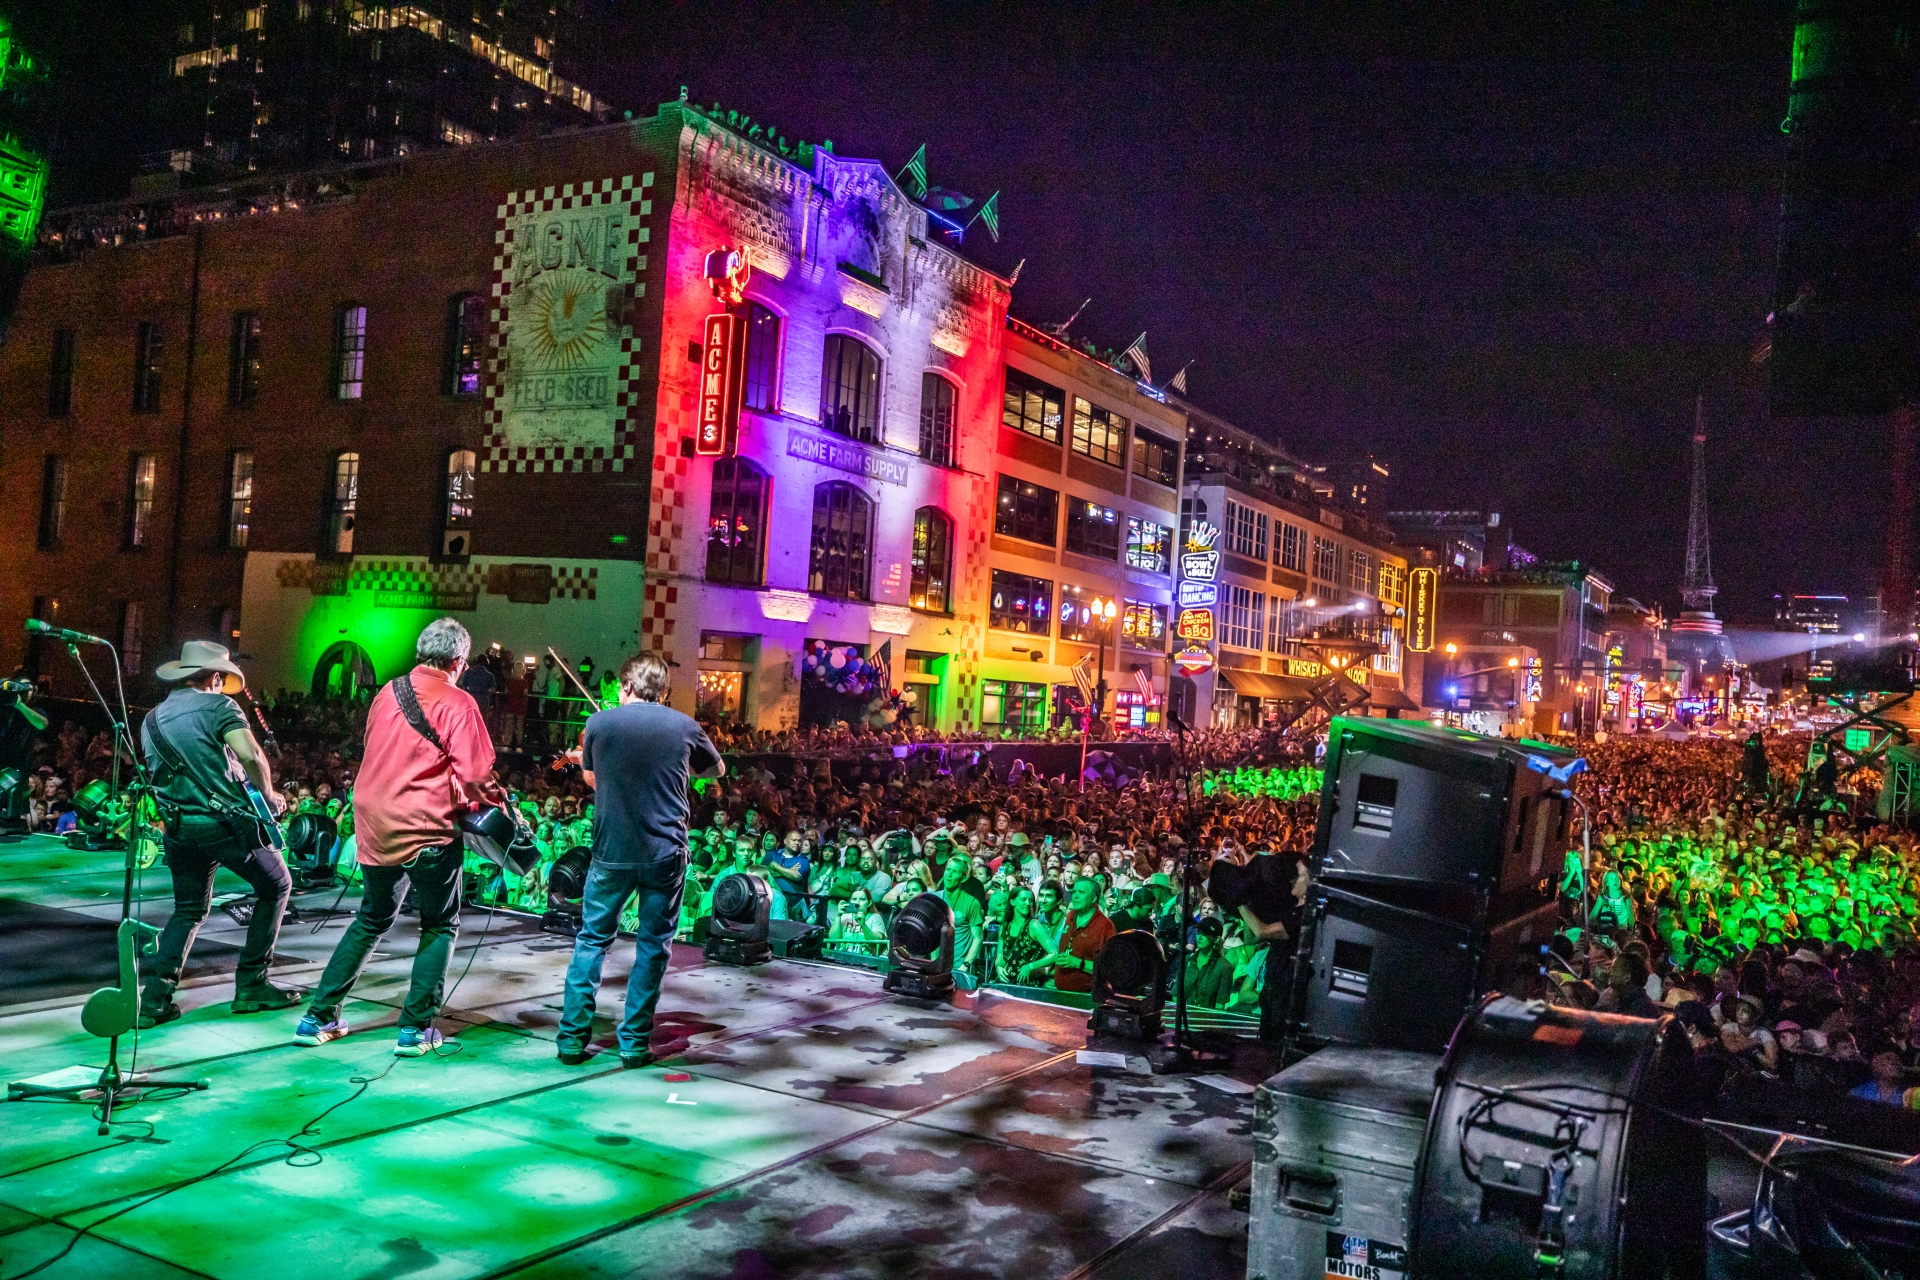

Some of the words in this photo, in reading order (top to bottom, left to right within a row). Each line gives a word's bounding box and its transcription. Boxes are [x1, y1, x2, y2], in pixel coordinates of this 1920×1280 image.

[514, 214, 624, 287] ACME
[704, 322, 723, 422] ACME
[514, 378, 556, 404] FEED
[565, 375, 608, 402] SEED
[791, 436, 826, 460] ACME
[829, 446, 862, 470] FARM
[864, 456, 906, 482] SUPPLY
[1186, 561, 1213, 570] BOWL
[1192, 568, 1212, 577] BULL
[377, 593, 404, 605] ACME
[406, 594, 434, 606] FARM
[436, 595, 473, 607] SUPPLY
[1182, 591, 1215, 604] DANCING
[1418, 570, 1429, 616] WHISKEY
[1183, 617, 1209, 625] CHICKEN
[1184, 626, 1210, 638] BBQ
[1416, 617, 1426, 650] RIVER
[1288, 658, 1322, 678] WHISKEY
[1327, 1258, 1381, 1280] MOTORS
